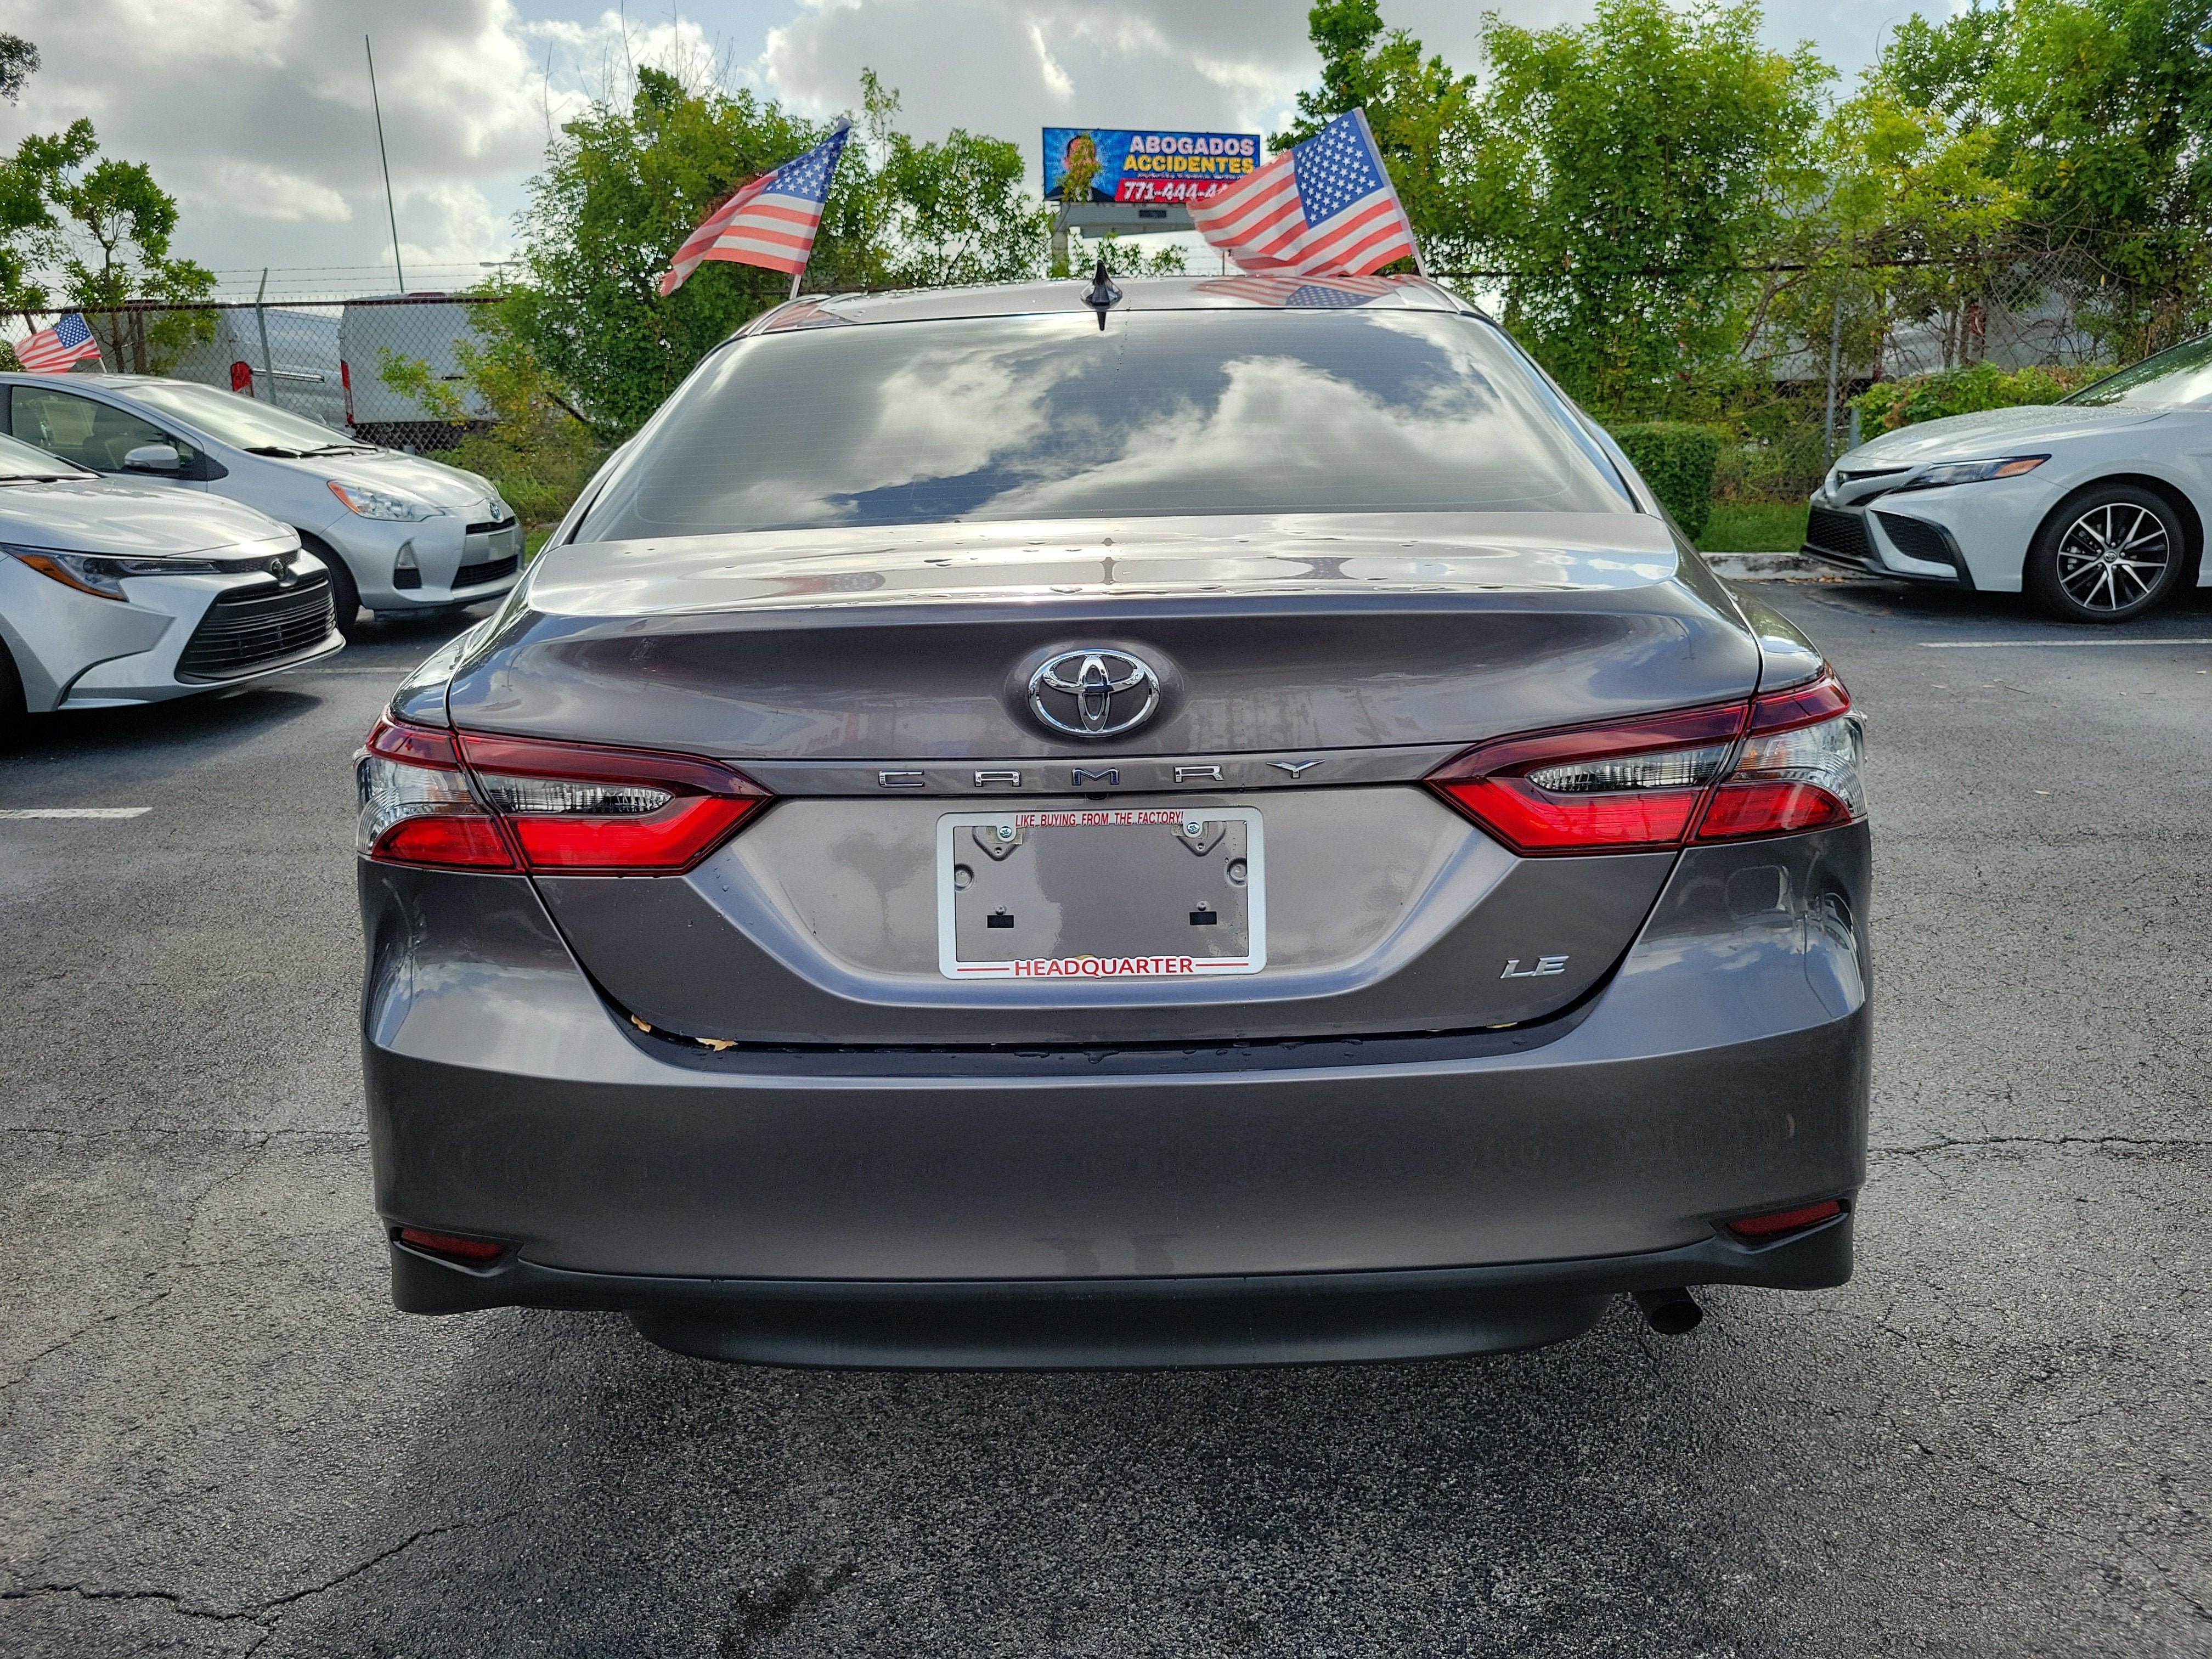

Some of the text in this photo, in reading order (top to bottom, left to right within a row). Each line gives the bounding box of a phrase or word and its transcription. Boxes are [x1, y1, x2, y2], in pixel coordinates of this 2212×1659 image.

[1129, 135, 1255, 156] ABOGADOS
[1123, 154, 1255, 173] ACCIDENTES
[879, 759, 1325, 788] CAMRY
[1015, 811, 1184, 827] LIKE BUYING FROM THE FACTORY!
[1015, 958, 1194, 977] HEADQUARTER
[1500, 954, 1570, 979] LE
